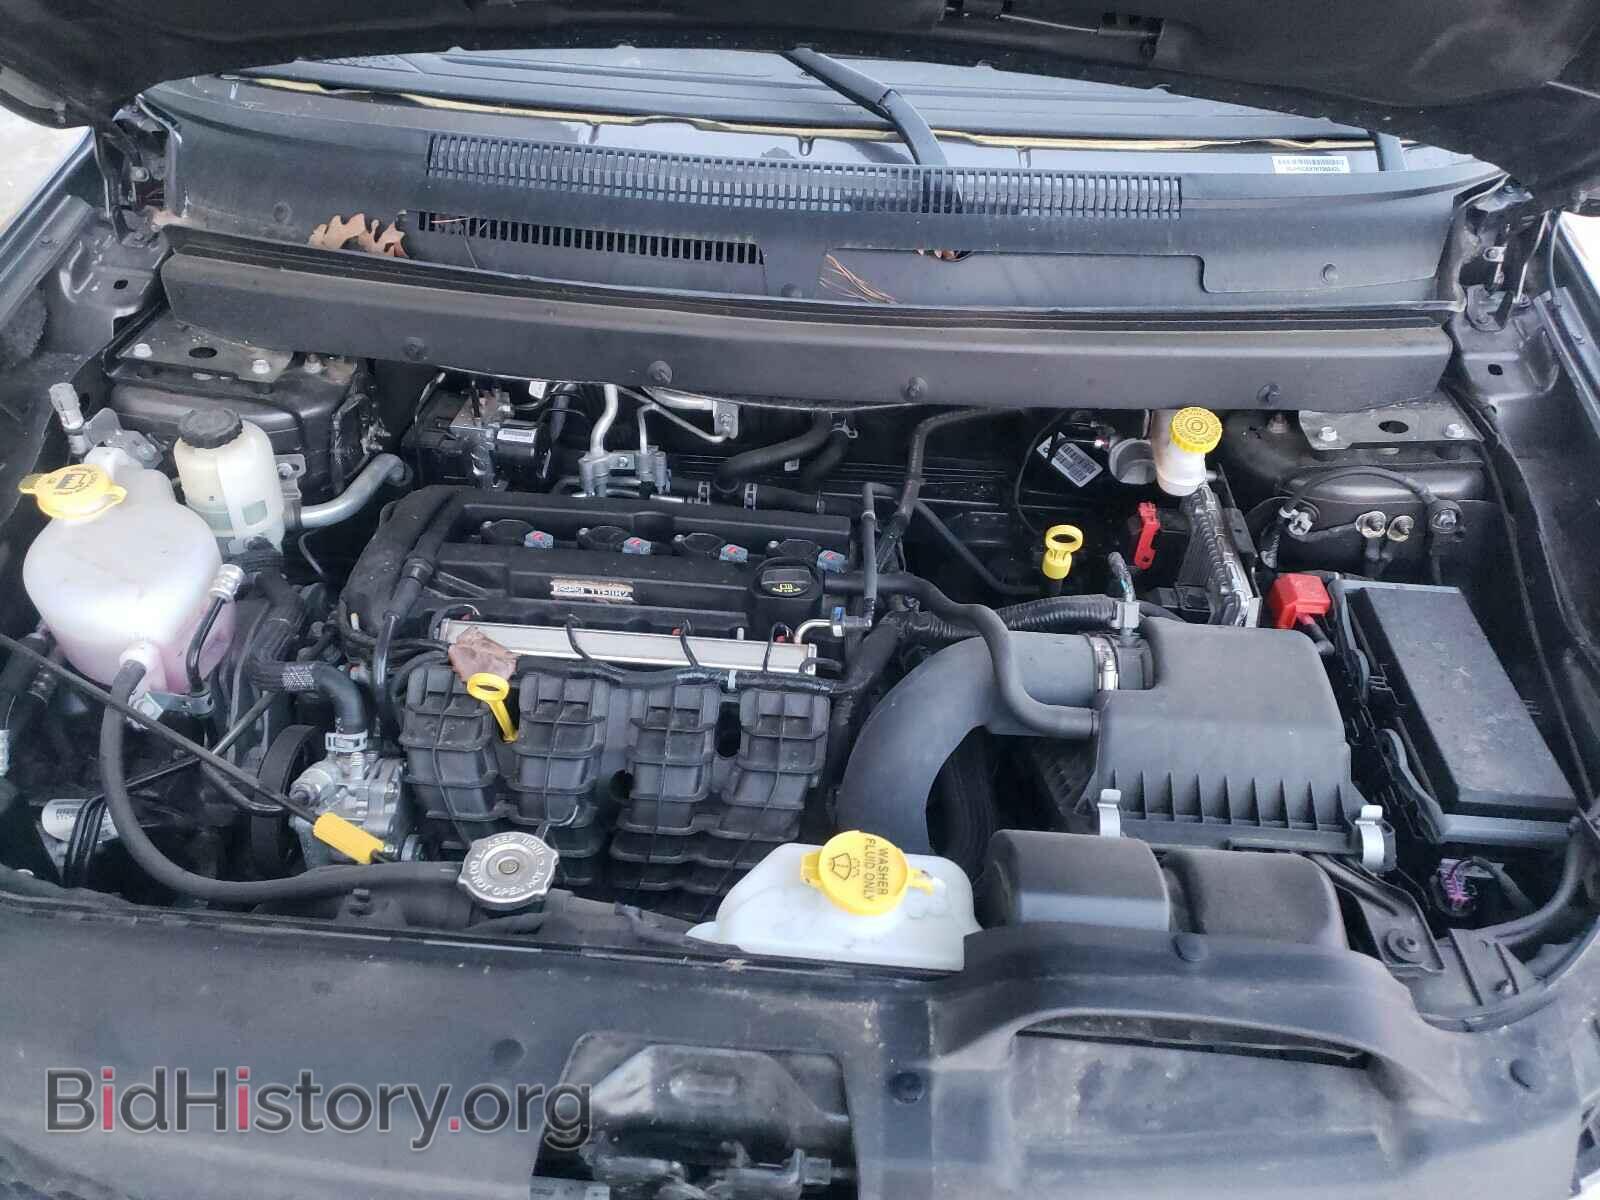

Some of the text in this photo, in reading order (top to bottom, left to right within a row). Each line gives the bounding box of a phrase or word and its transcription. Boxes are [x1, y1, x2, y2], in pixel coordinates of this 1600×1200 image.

[863, 837, 877, 902] FLUID ONLY
[876, 847, 889, 896] WASHER
